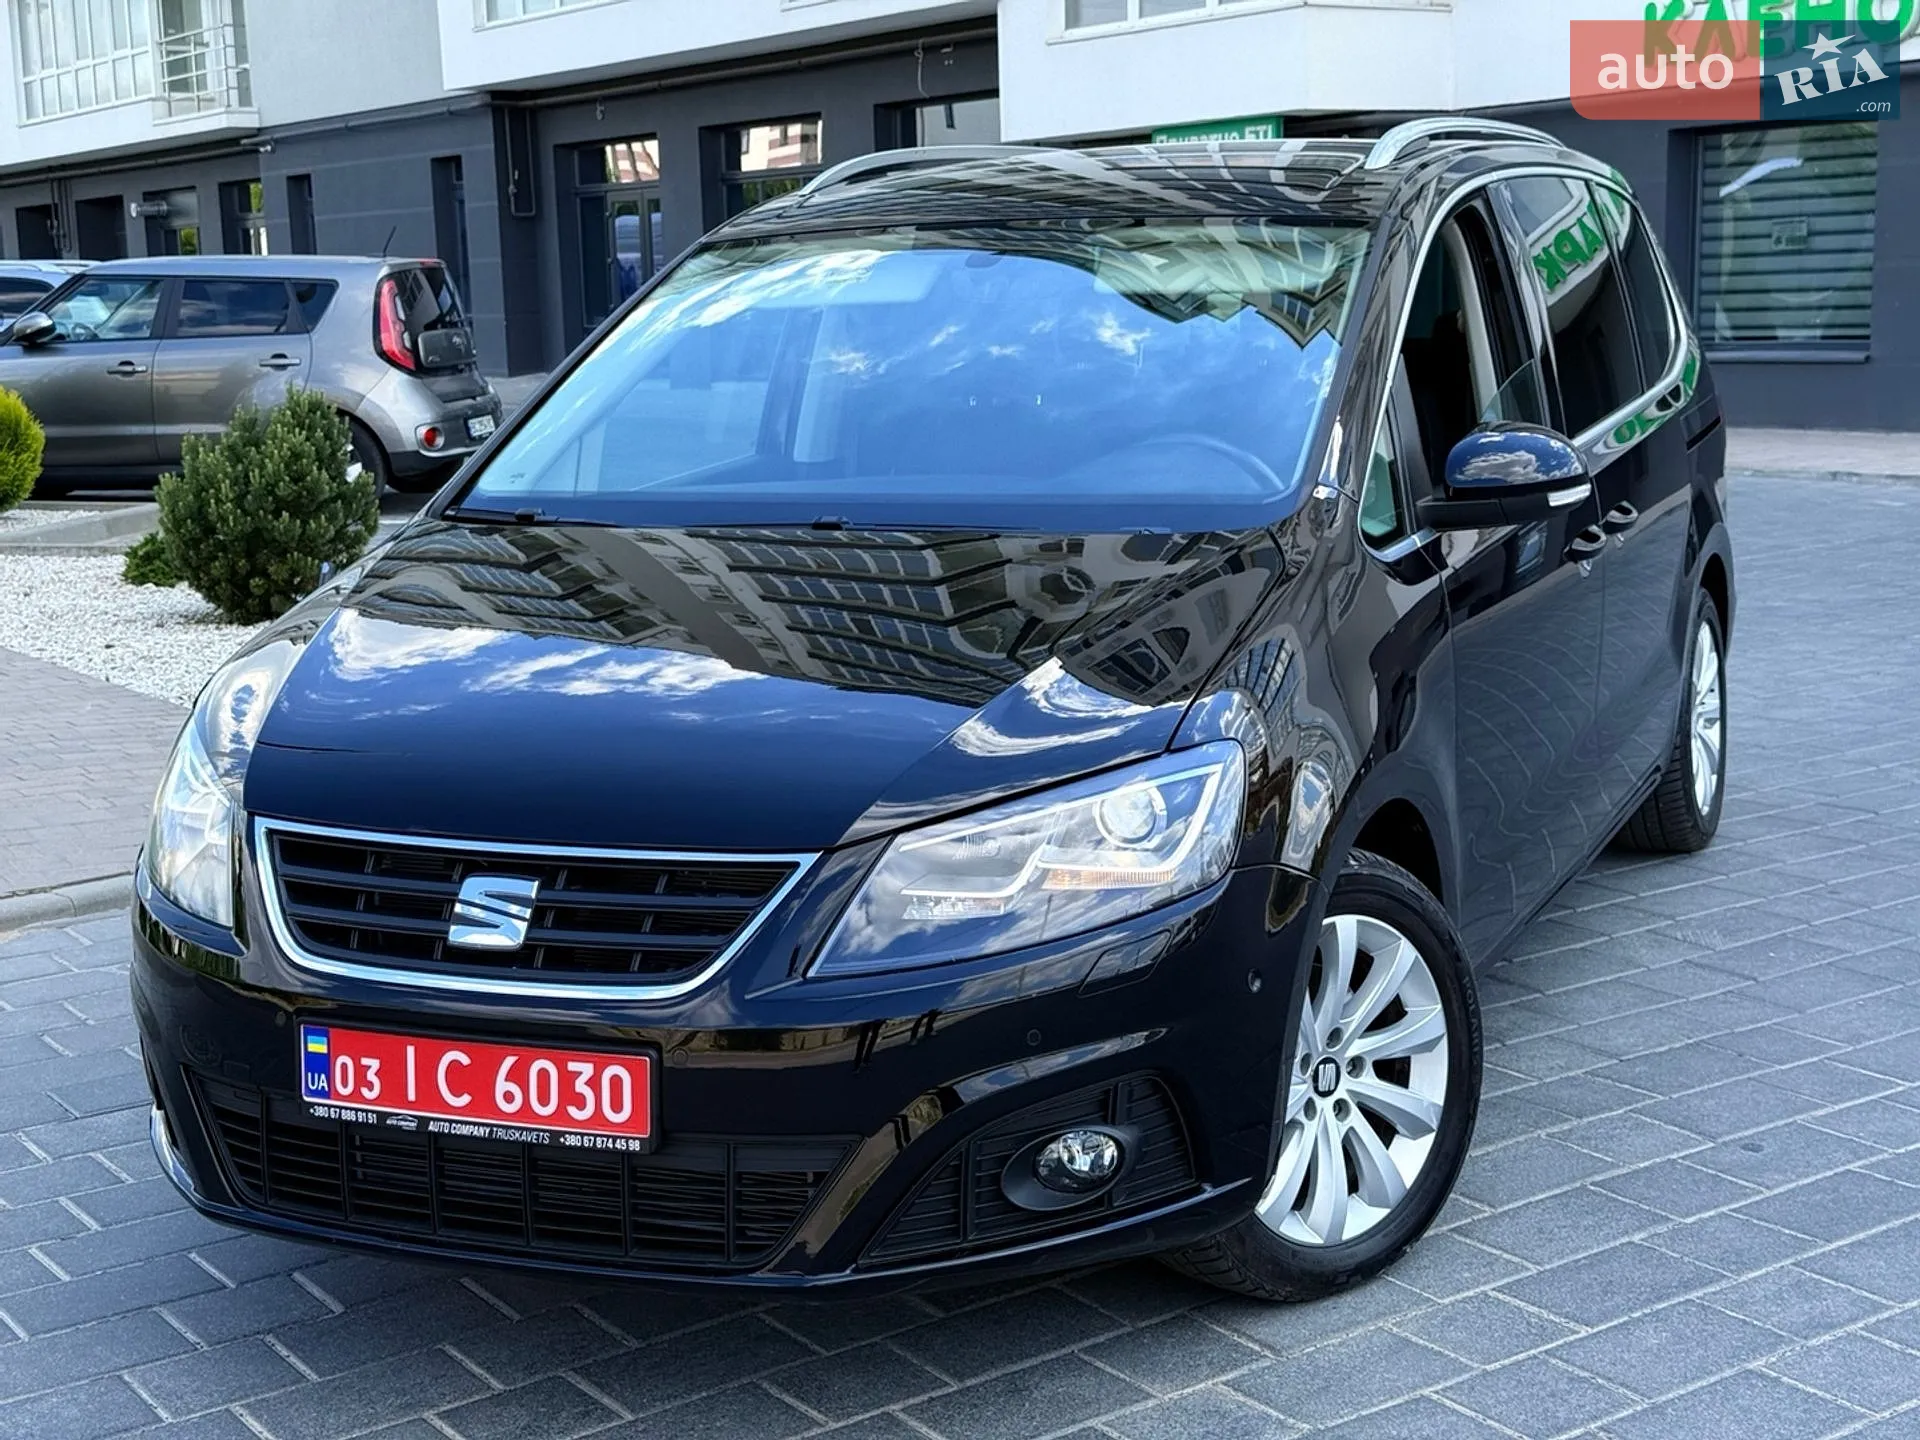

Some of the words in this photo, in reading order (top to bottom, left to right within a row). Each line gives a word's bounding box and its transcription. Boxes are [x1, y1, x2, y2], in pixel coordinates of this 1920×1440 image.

[307, 1072, 329, 1092] UA
[334, 1054, 382, 1101] 03
[495, 1055, 633, 1125] 6030
[309, 1105, 329, 1118] +380
[330, 1108, 340, 1119] 67
[428, 1120, 450, 1134] AUTO
[450, 1123, 490, 1138] COMPANY
[491, 1126, 550, 1145] TRUSKAVETS
[559, 1135, 582, 1147] +380
[583, 1136, 595, 1148] 67
[596, 1137, 614, 1149] 874
[614, 1139, 627, 1150] 45
[628, 1140, 641, 1151] 98
